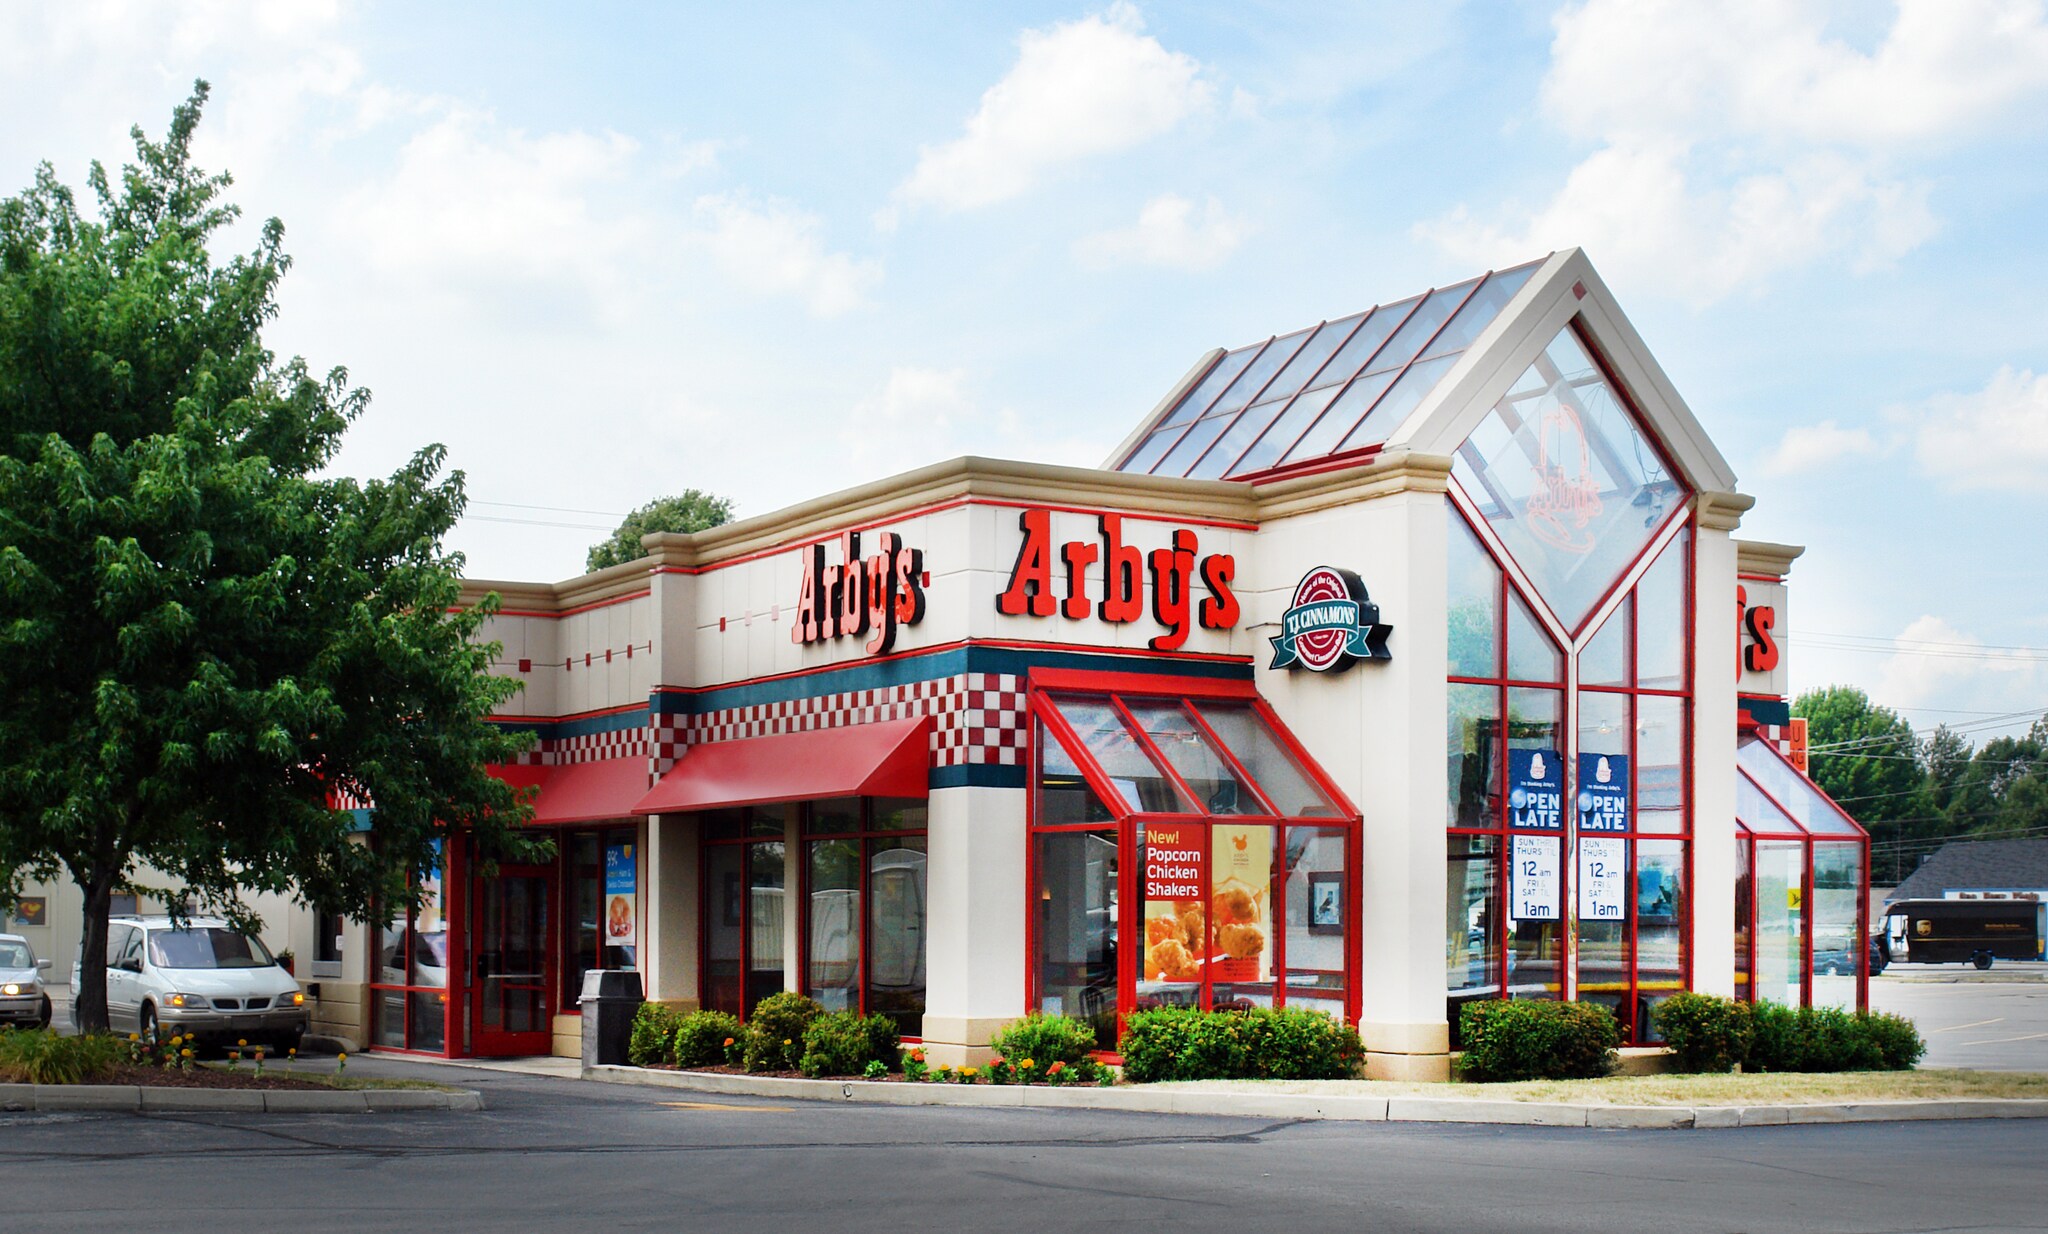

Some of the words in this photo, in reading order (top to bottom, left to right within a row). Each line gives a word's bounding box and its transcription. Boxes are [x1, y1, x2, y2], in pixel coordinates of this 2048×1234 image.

[996, 509, 1240, 650] Arby's
[790, 530, 925, 655] Arby's
[1299, 583, 1313, 604] Home
[1312, 577, 1318, 587] of
[1318, 575, 1326, 584] the
[1326, 576, 1344, 598] Original
[1300, 605, 1355, 628] CINNAMONS
[1511, 788, 1560, 810] OPEN
[1578, 791, 1625, 813] OPEN
[1515, 809, 1560, 828] LATE
[1581, 812, 1625, 830] LATE
[1147, 830, 1180, 845] New!
[1518, 838, 1534, 847] SUN
[1584, 840, 1600, 848] SUN
[1147, 847, 1201, 864] Popcorn
[1517, 847, 1543, 856] THURS
[1583, 849, 1608, 857] THURS
[1147, 865, 1198, 879] Chicken
[1522, 861, 1537, 877] 12
[1539, 868, 1552, 877] am
[1589, 862, 1604, 878] 12
[1606, 870, 1618, 878] am
[1147, 882, 1199, 897] Shakers
[1522, 888, 1536, 897] SAT
[1588, 889, 1602, 898] SAT
[1523, 900, 1550, 916] 1am
[1592, 901, 1618, 916] 1am
